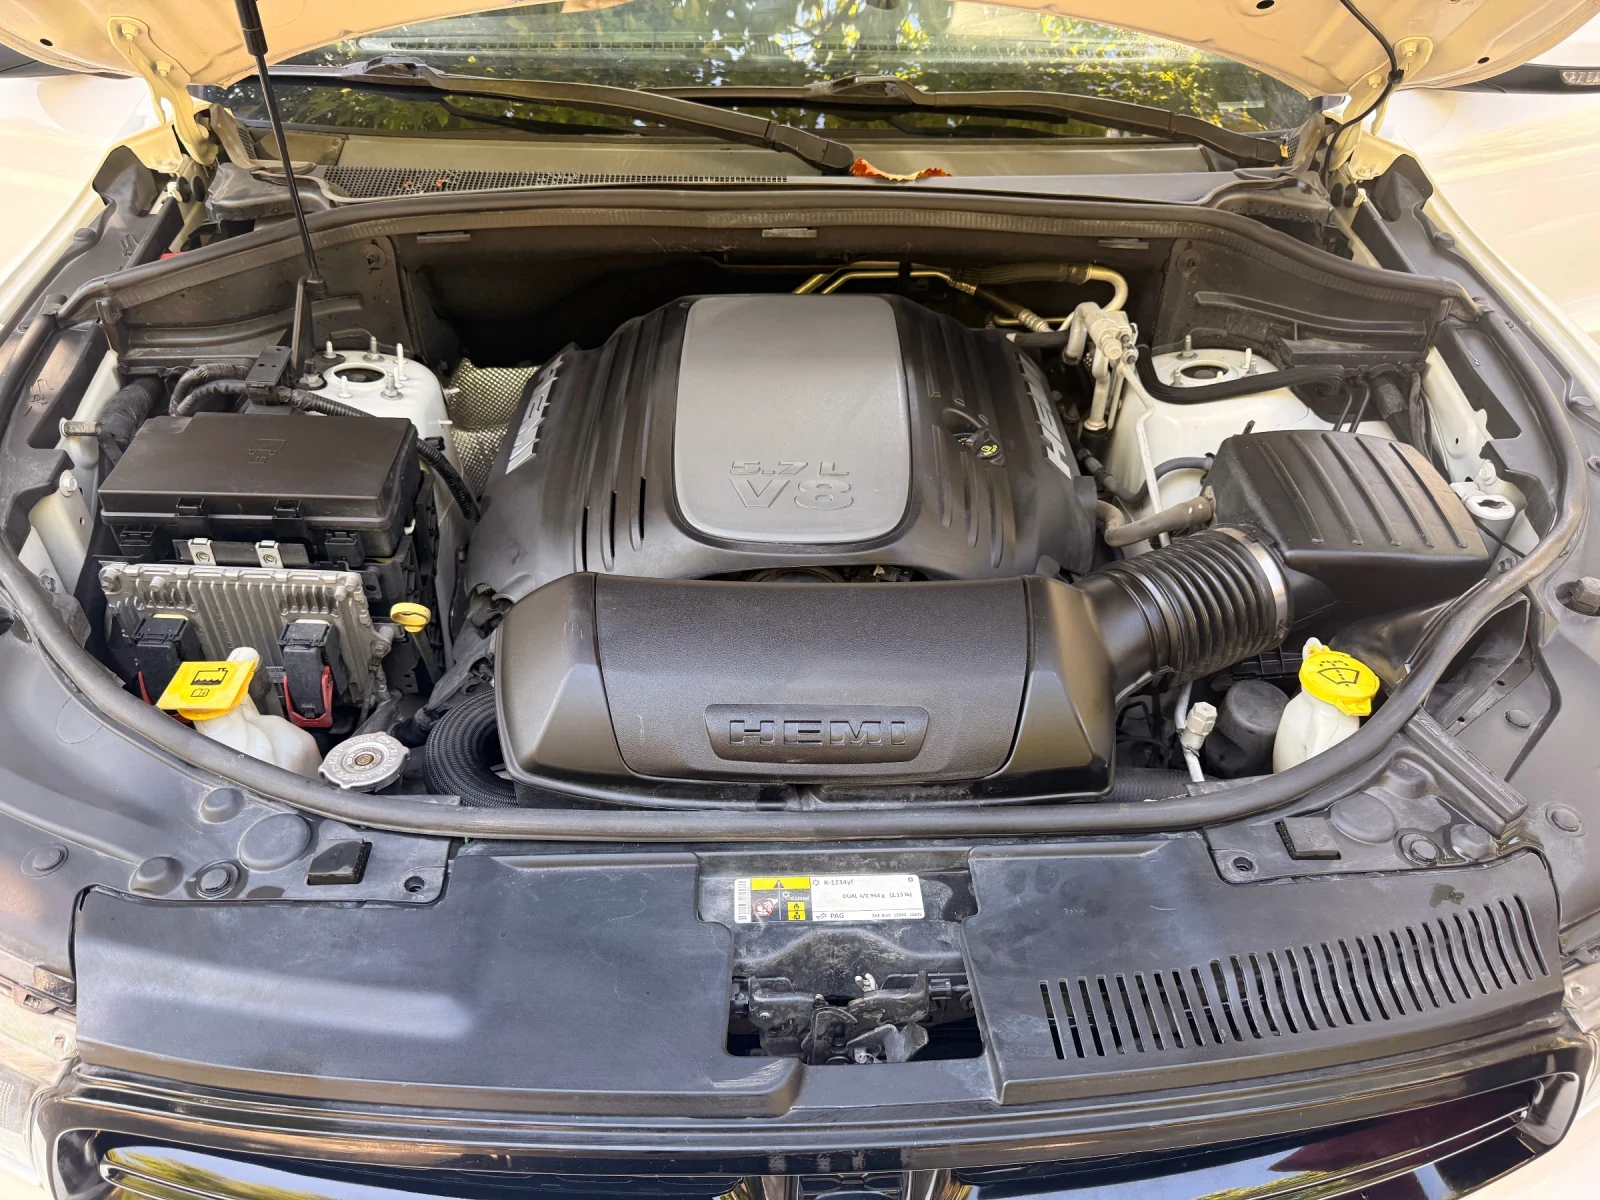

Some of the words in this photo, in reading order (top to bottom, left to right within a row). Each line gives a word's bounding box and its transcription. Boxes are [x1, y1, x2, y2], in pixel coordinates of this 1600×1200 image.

[1016, 352, 1072, 480] HEMI
[729, 478, 854, 511] V8
[729, 719, 906, 746] HEMI
[823, 878, 854, 886] R-1234yf
